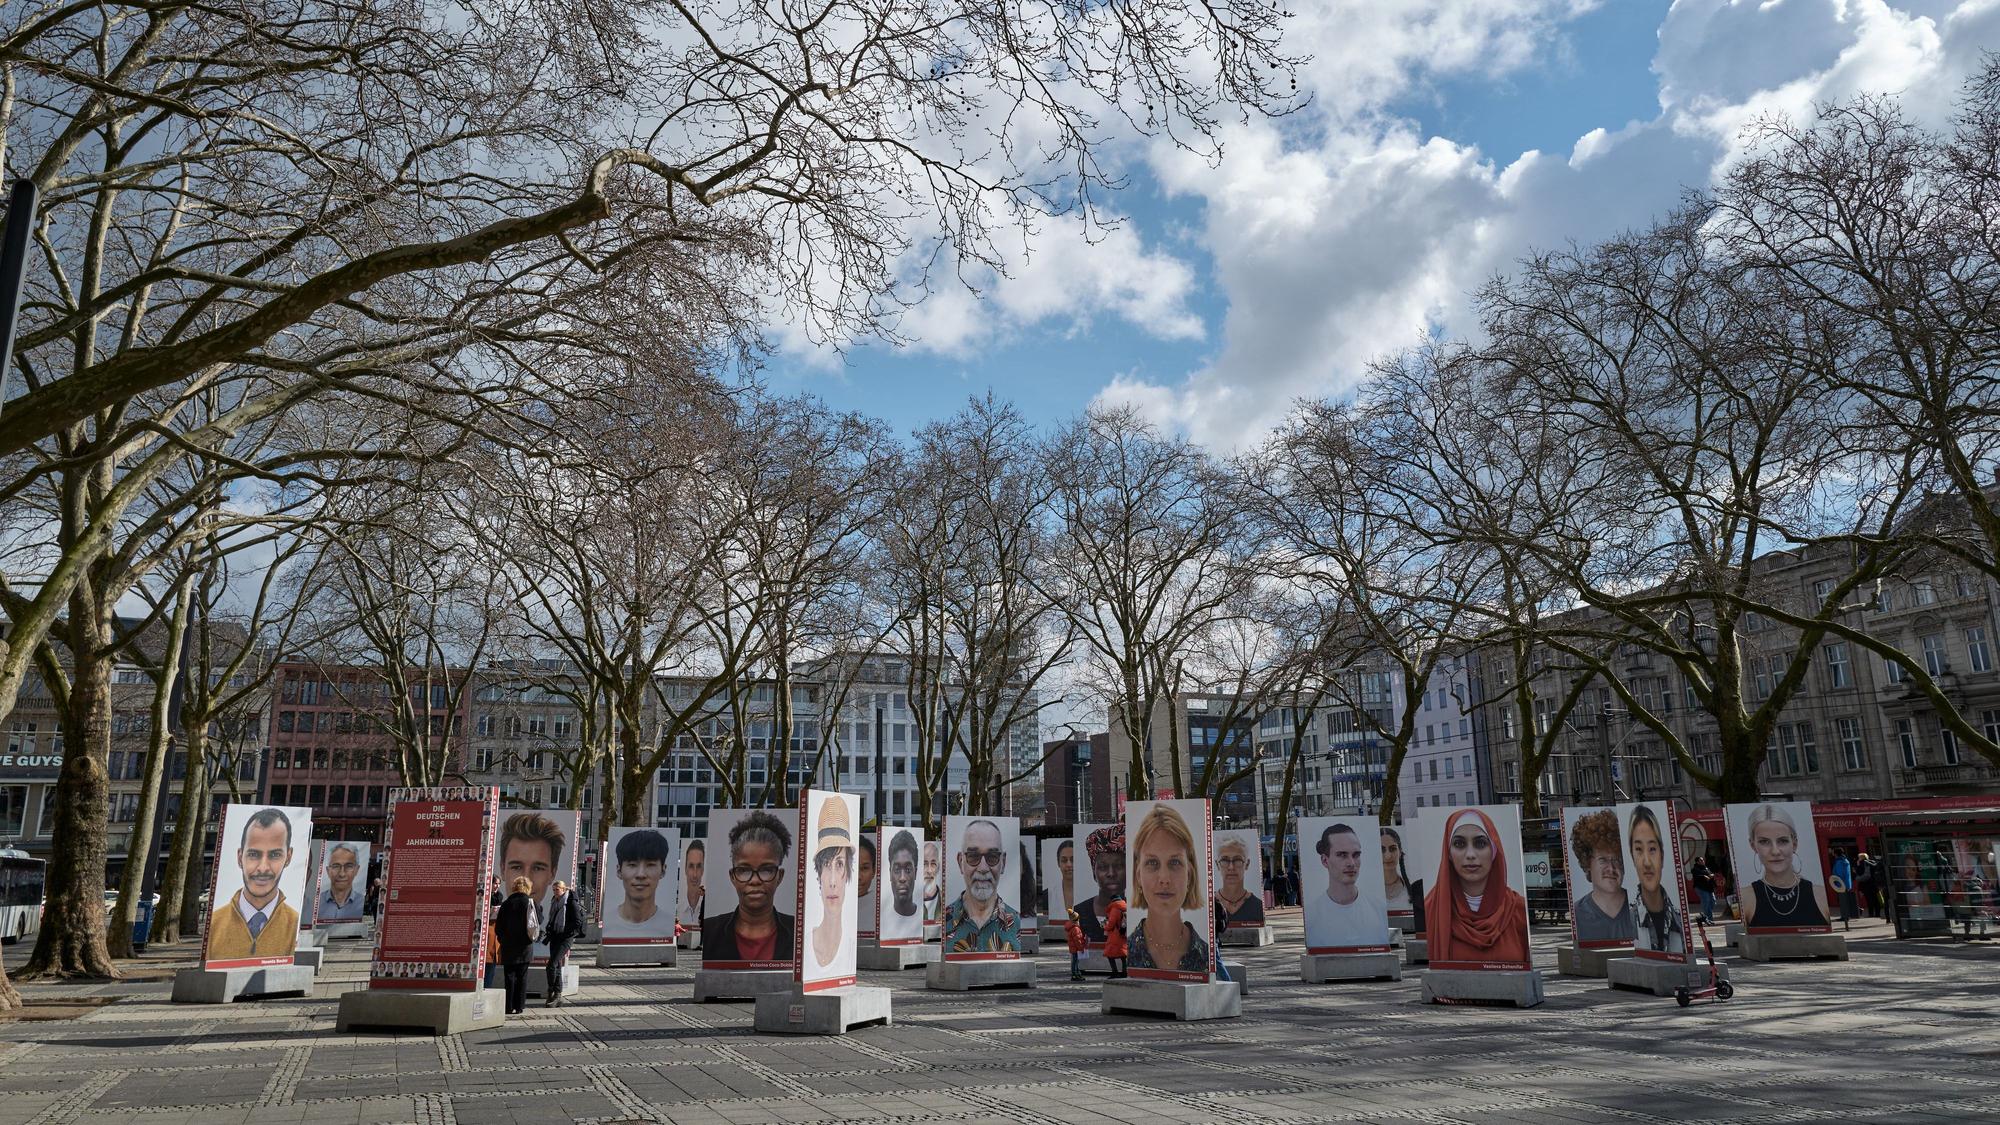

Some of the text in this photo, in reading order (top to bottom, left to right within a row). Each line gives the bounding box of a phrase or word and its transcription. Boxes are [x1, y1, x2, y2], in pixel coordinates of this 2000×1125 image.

[0, 756, 63, 766] E GUYS
[430, 829, 444, 838] 21.
[1668, 806, 1679, 859] JAHRHUNDERTS
[480, 899, 488, 950] DEUTSCHEN
[488, 794, 498, 860] JAHRHUNDERTS
[1679, 890, 1689, 931] DEUTSCHEN
